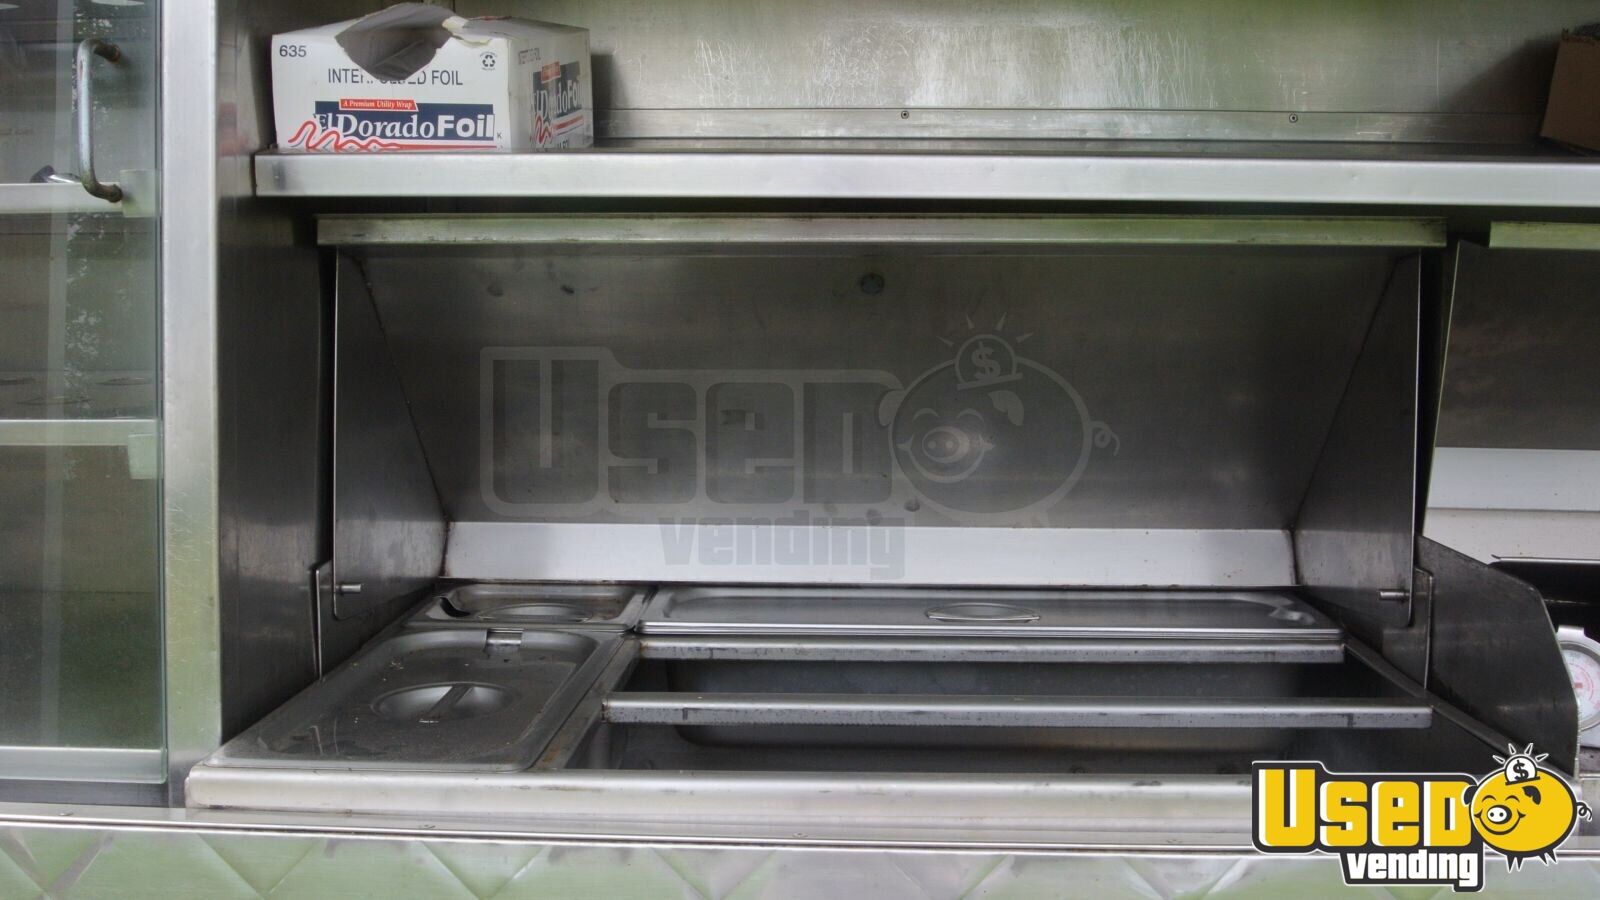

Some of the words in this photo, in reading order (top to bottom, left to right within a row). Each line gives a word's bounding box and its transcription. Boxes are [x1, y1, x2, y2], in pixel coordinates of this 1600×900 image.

[279, 45, 307, 58] 635
[431, 70, 464, 86] FOIL
[376, 101, 395, 110] Utility
[396, 101, 412, 110] Wrap
